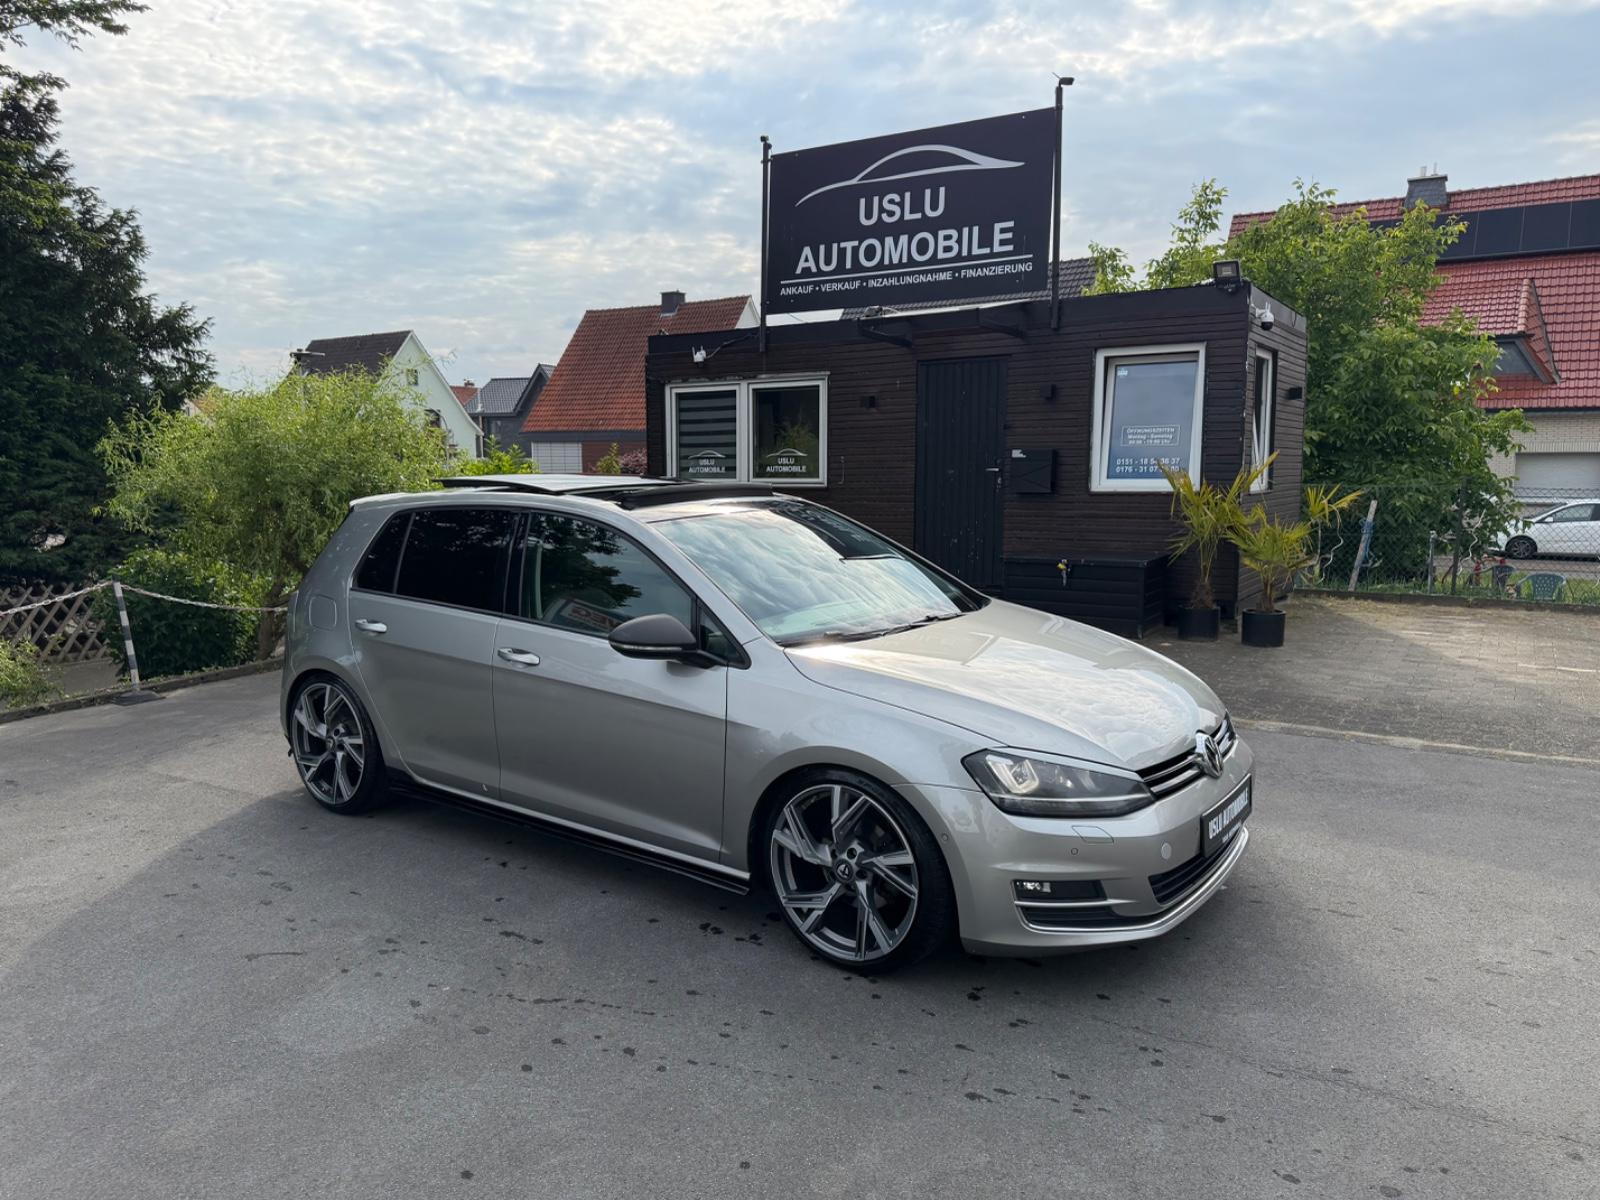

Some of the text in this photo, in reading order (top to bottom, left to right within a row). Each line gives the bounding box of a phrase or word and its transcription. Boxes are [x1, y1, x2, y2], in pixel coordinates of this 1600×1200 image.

[859, 187, 946, 226] USLU
[795, 220, 1015, 274] AUTOMOBILE
[780, 261, 1033, 296] ANKAUF VERKAUF INZAHLUNGNAHME FINANZIERUNG
[699, 458, 715, 466] USLU
[778, 457, 795, 465] USLU
[688, 466, 726, 474] AUTOMOBILE
[766, 465, 806, 473] AUTOMOBILE
